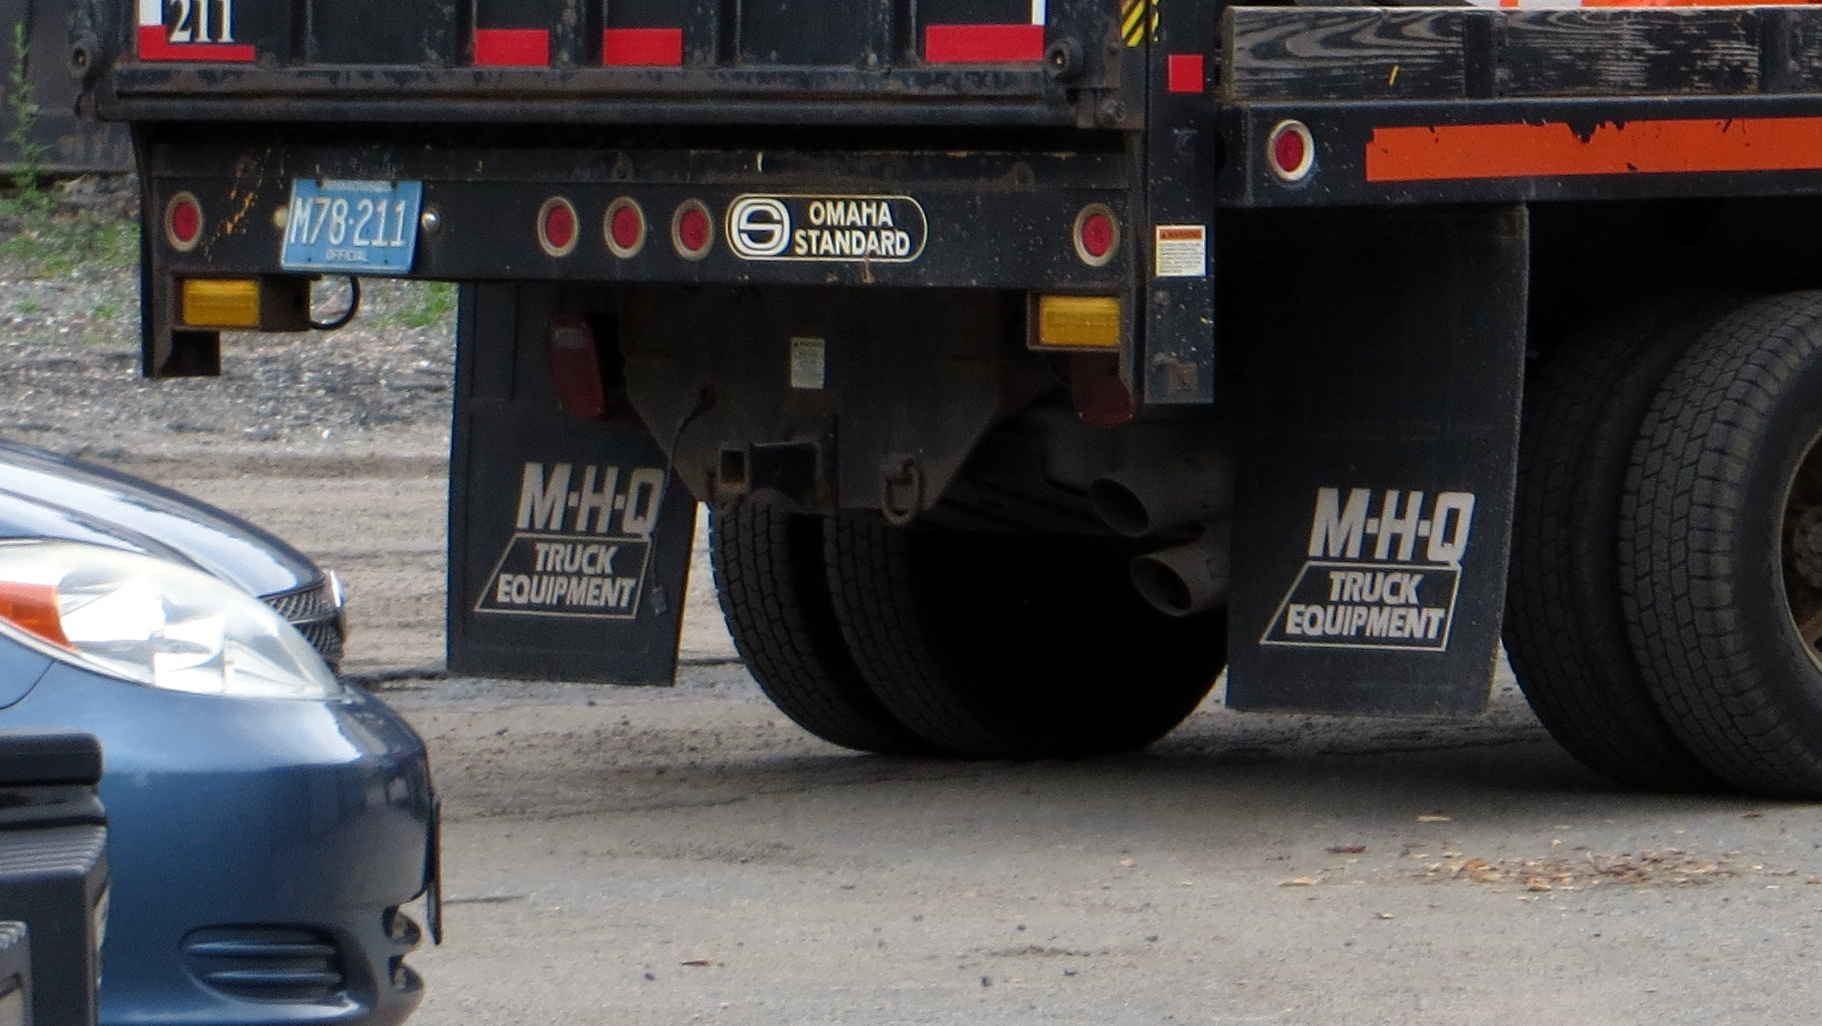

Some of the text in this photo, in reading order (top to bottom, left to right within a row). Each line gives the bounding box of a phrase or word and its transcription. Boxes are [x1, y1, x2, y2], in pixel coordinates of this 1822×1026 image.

[808, 200, 894, 227] OMAHA
[325, 248, 368, 262] OFFICIAL
[794, 228, 911, 257] STANDARD
[534, 542, 619, 575] TRUCK
[496, 573, 637, 608] EQUIPMENT
[1329, 571, 1424, 605] TRUCK
[1285, 603, 1447, 640] EQUIPMENT
